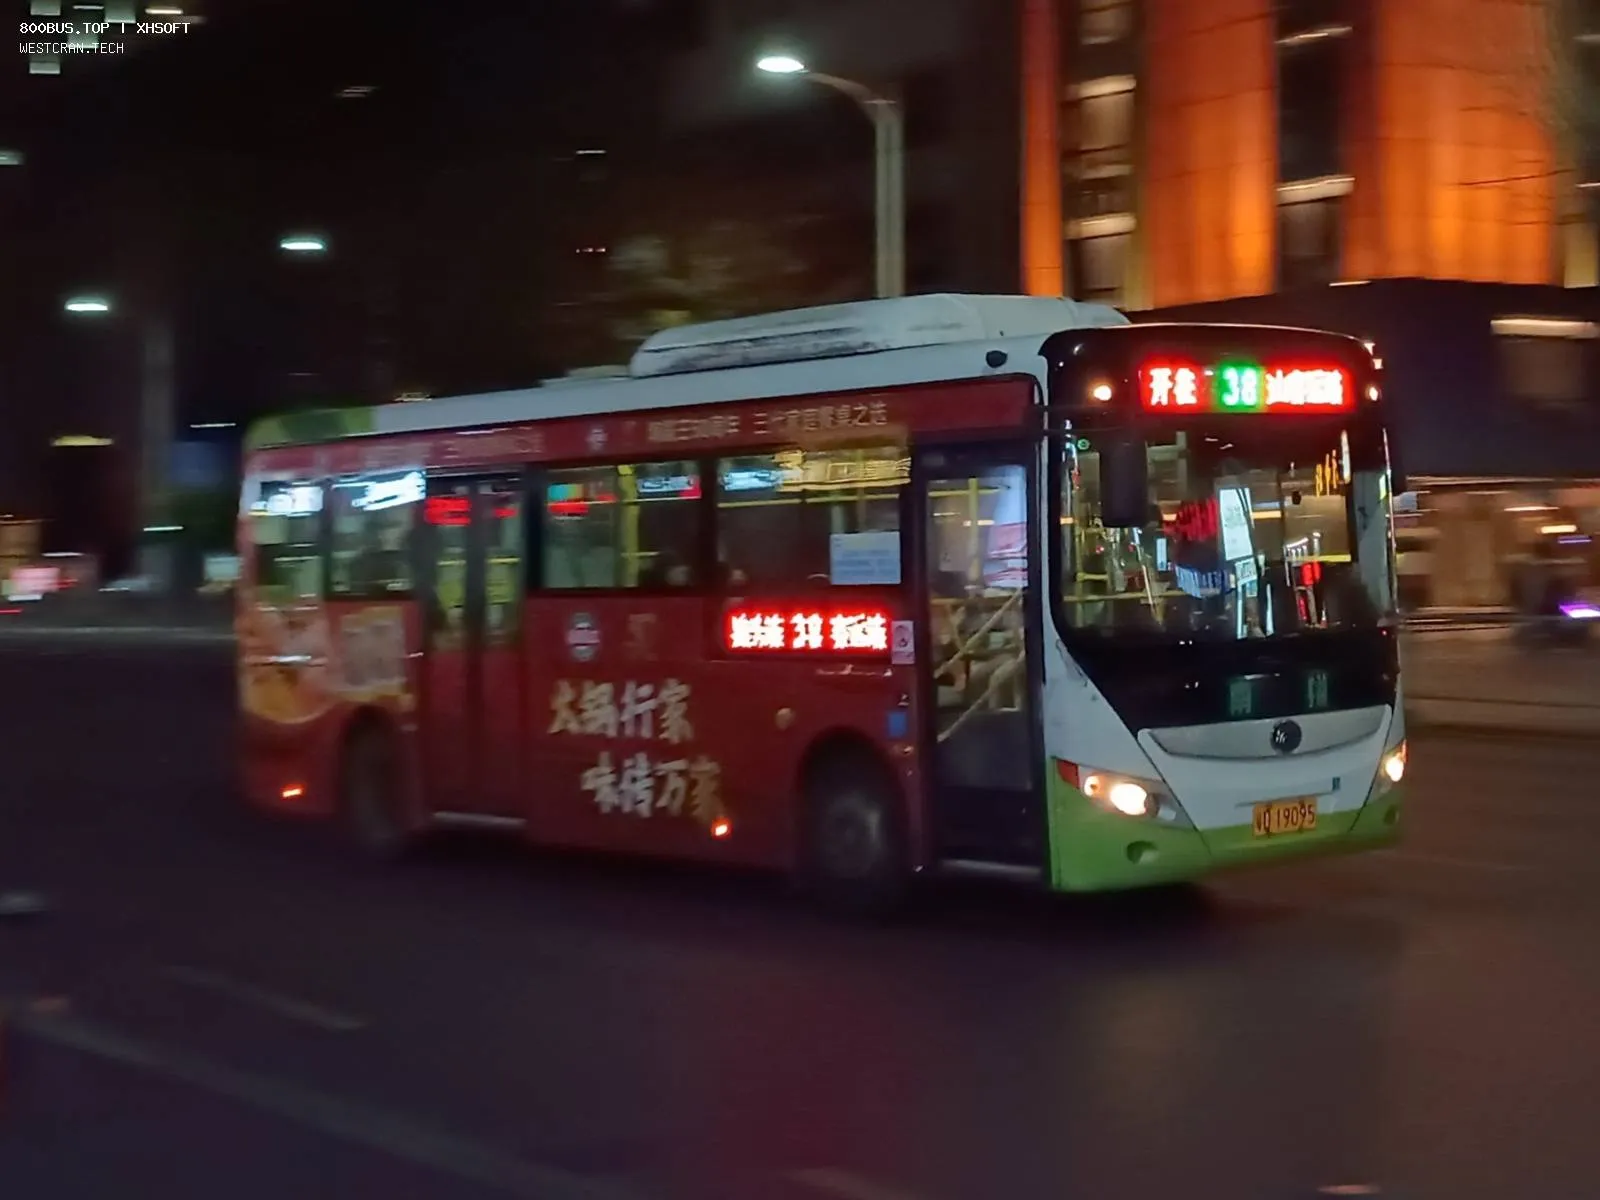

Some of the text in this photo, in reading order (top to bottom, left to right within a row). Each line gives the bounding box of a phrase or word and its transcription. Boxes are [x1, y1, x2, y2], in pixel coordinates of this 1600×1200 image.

[1222, 367, 1258, 406] 38
[547, 678, 693, 743] 火锅行家
